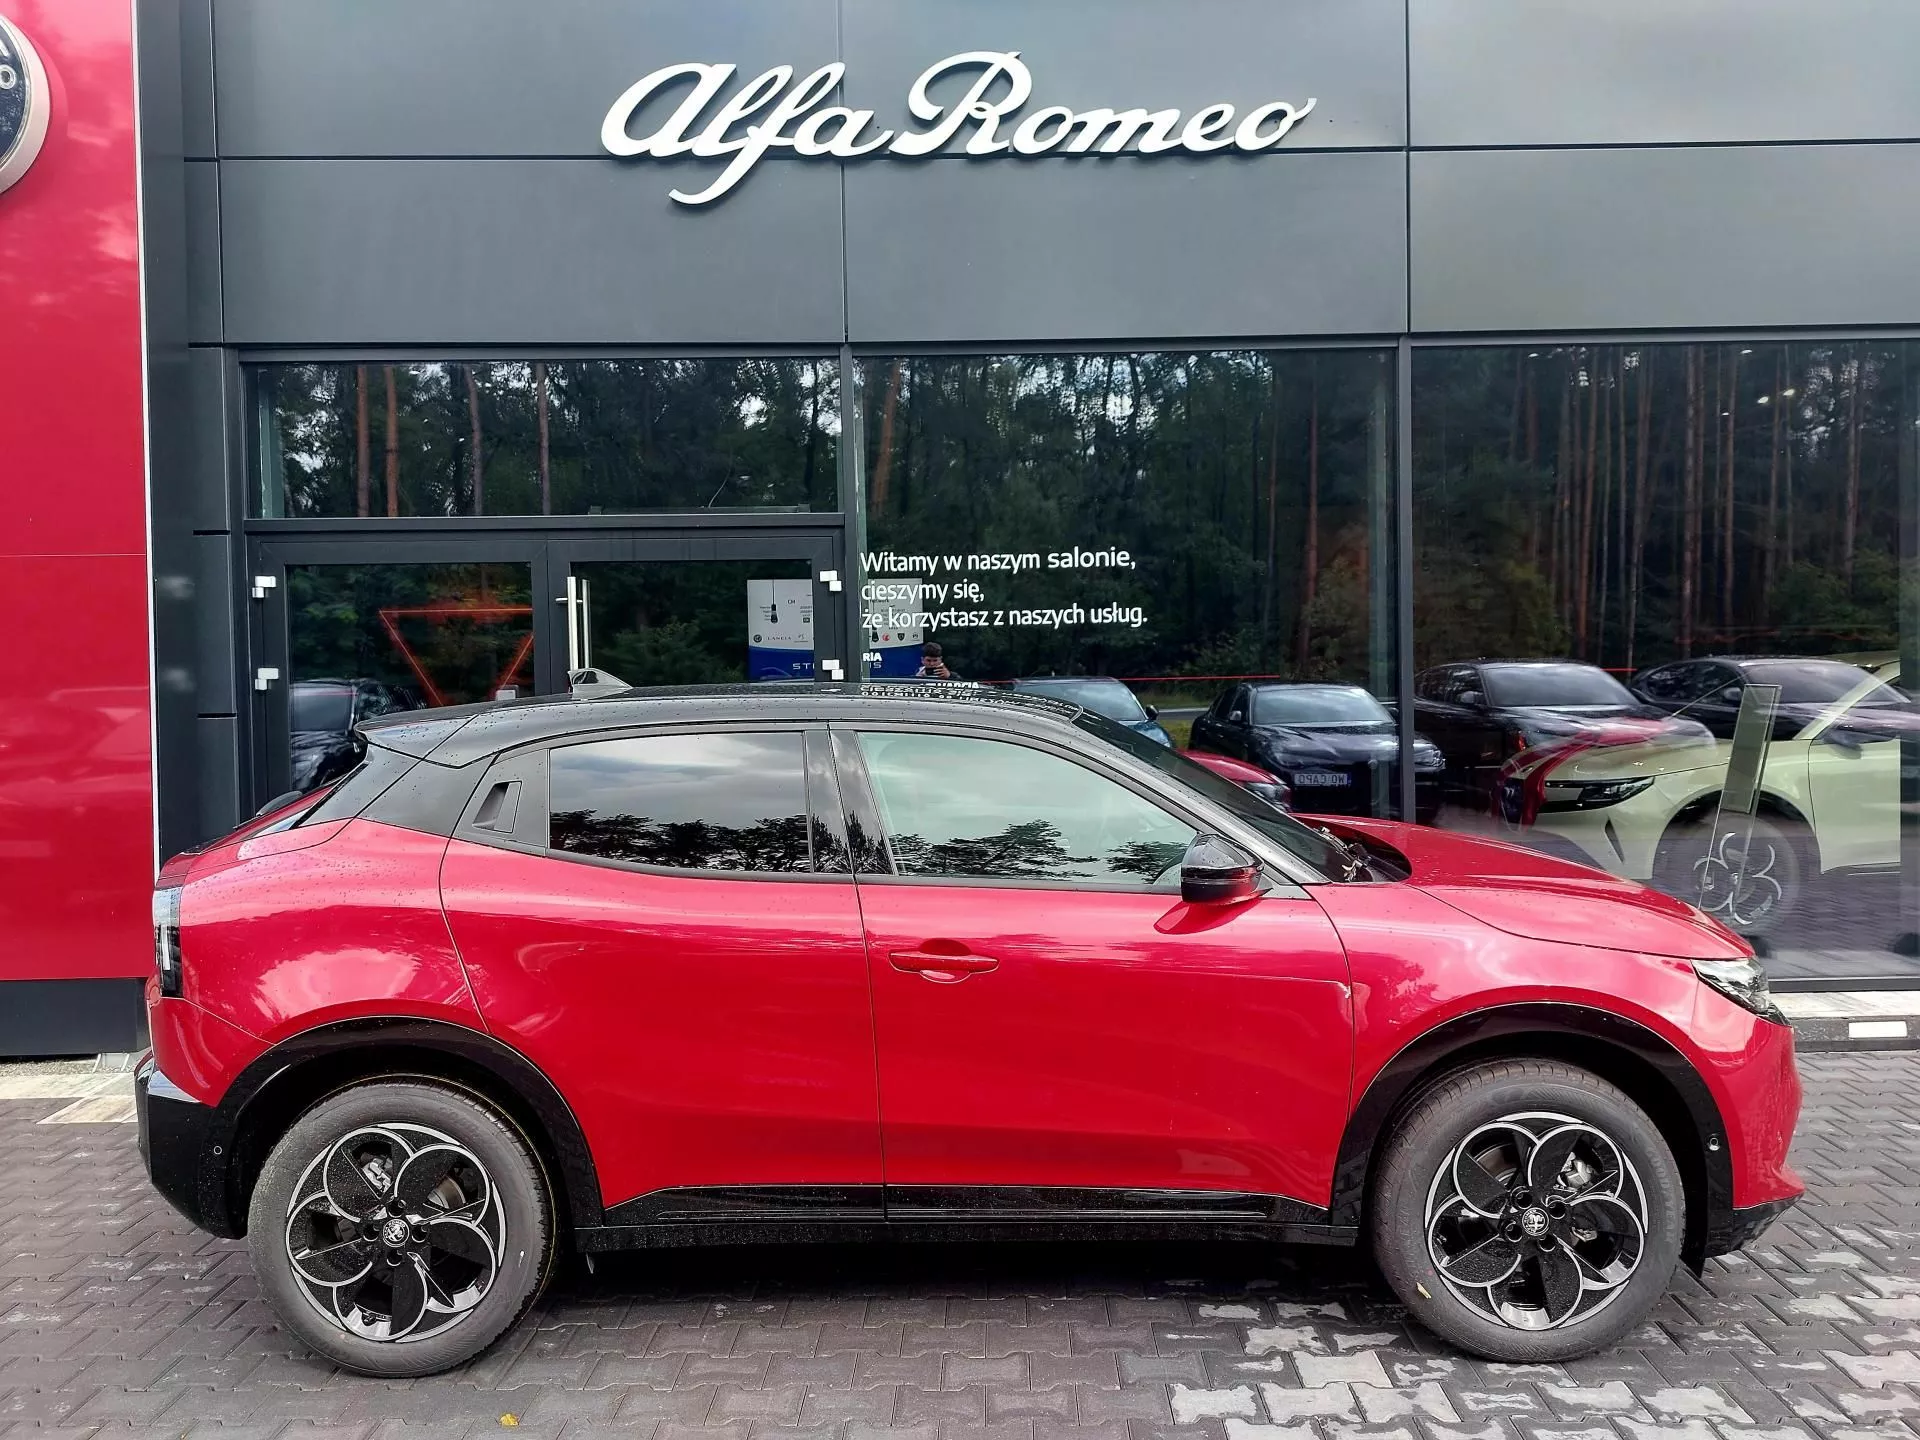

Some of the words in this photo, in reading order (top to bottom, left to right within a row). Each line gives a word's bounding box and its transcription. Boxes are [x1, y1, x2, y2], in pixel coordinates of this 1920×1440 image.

[601, 62, 893, 204] Alfa
[888, 51, 1317, 155] Romeo
[861, 551, 938, 576] Witamy
[943, 555, 963, 571] w
[967, 553, 1041, 575] naszym
[1047, 546, 1136, 570] salonie,
[861, 580, 948, 605] cieszymy
[953, 578, 985, 603] się,
[861, 608, 883, 629] że
[888, 606, 988, 632] korzystasz
[993, 610, 1005, 626] z
[1009, 603, 1085, 630] naszych
[1090, 602, 1148, 628] usług.
